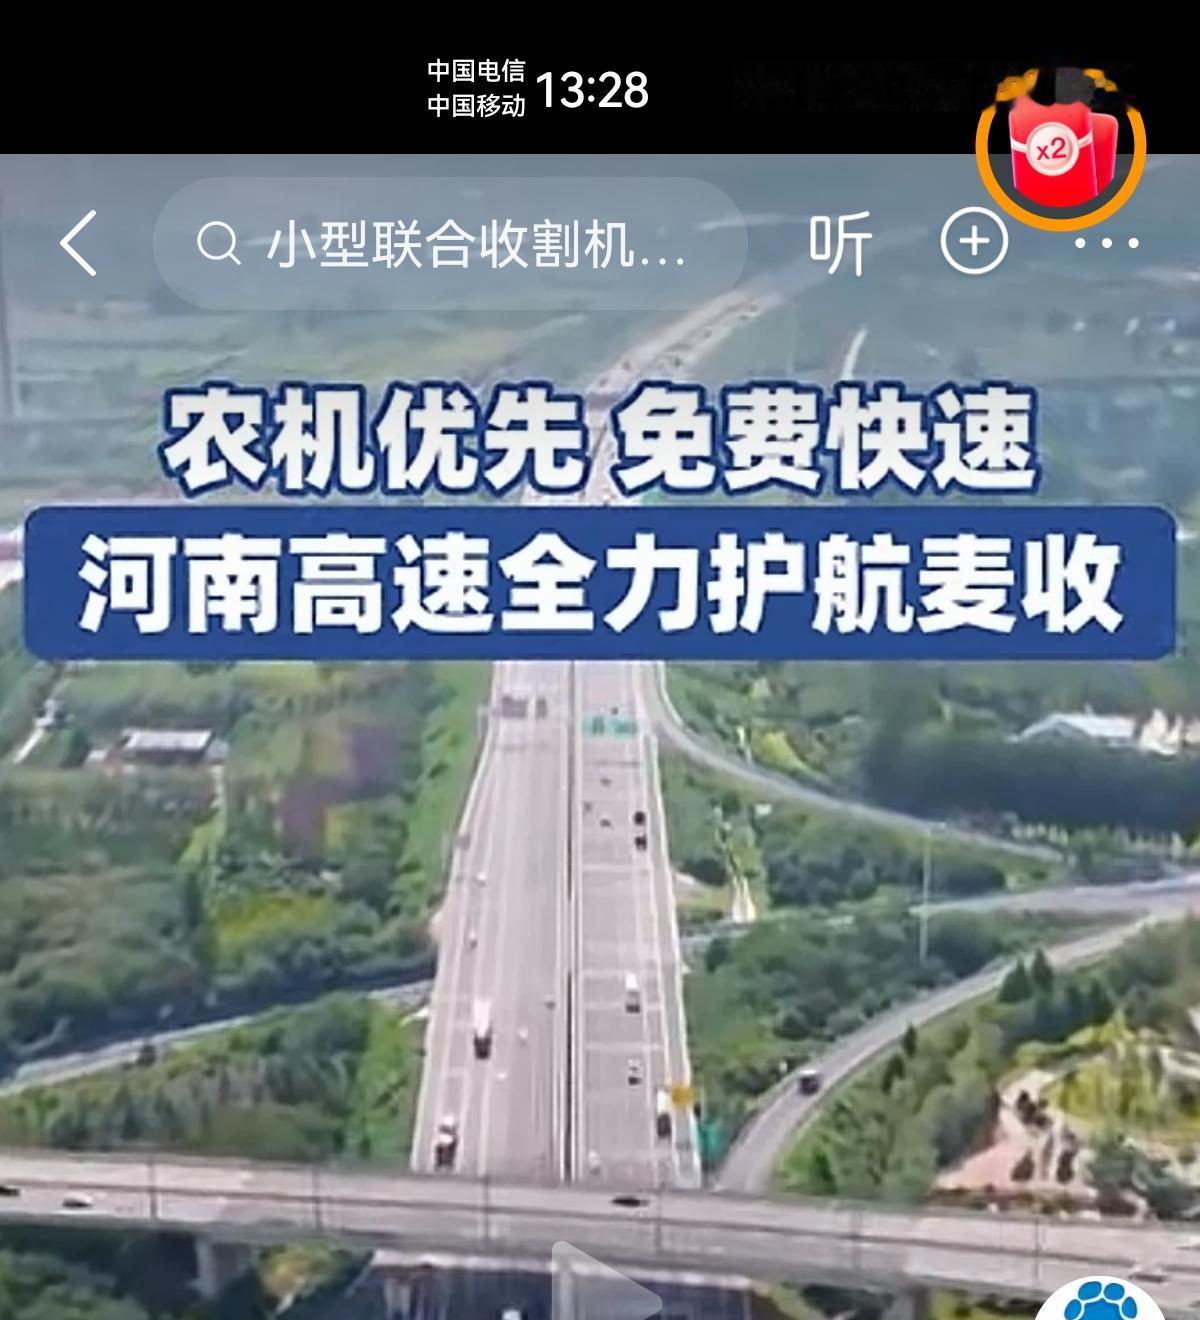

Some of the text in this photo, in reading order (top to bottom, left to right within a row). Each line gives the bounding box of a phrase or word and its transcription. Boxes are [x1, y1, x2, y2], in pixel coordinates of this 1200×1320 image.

[427, 58, 527, 83] 中国电信
[427, 92, 527, 118] 中国移动
[536, 70, 649, 109] 13:28
[809, 211, 873, 277] 听
